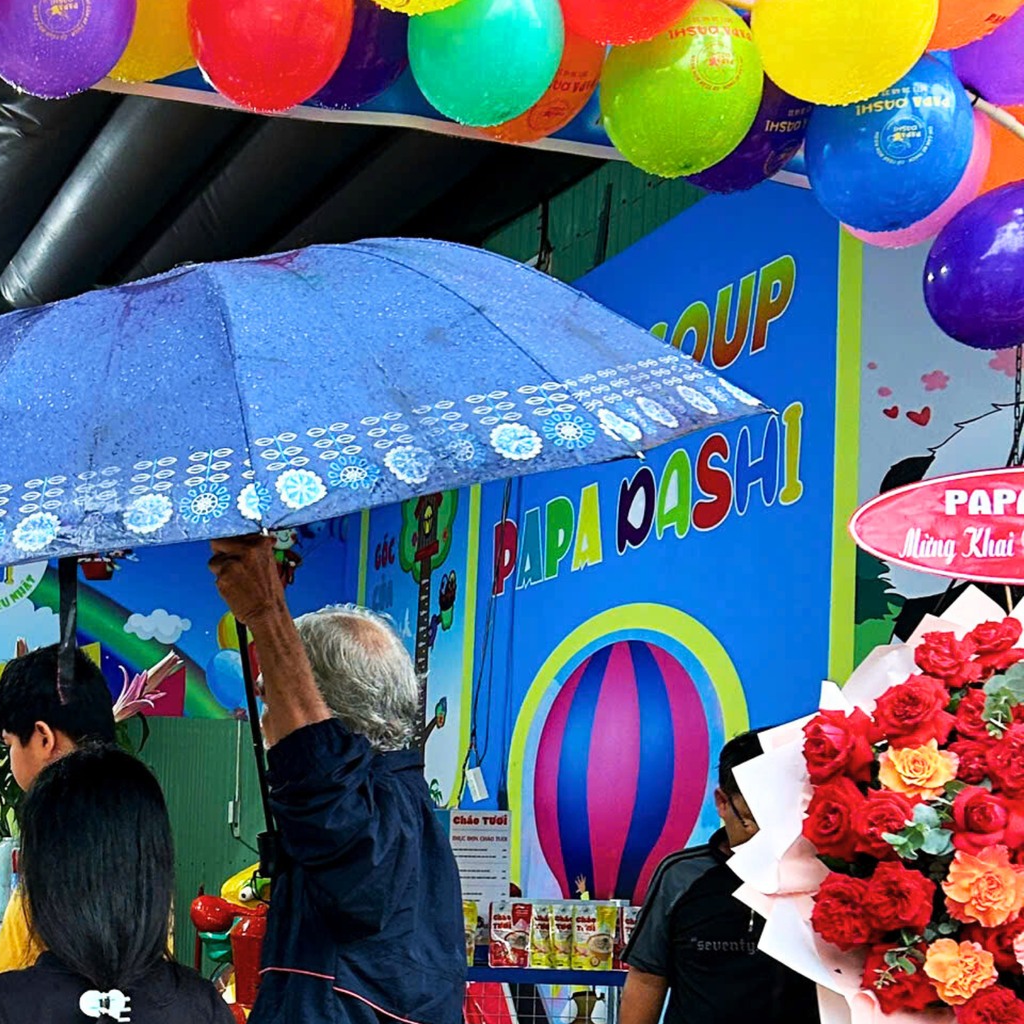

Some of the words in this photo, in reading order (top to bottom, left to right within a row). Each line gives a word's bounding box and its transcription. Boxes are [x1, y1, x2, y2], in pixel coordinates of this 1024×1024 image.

[856, 97, 907, 116] DASHI
[912, 95, 951, 107] PAPA
[649, 254, 797, 371] OUP
[491, 482, 604, 600] PAPA
[616, 400, 805, 556] DASHI
[899, 527, 957, 565] Mừng
[961, 526, 1016, 559] Khai
[453, 815, 479, 825] Cháo
[482, 814, 507, 825] Tươi
